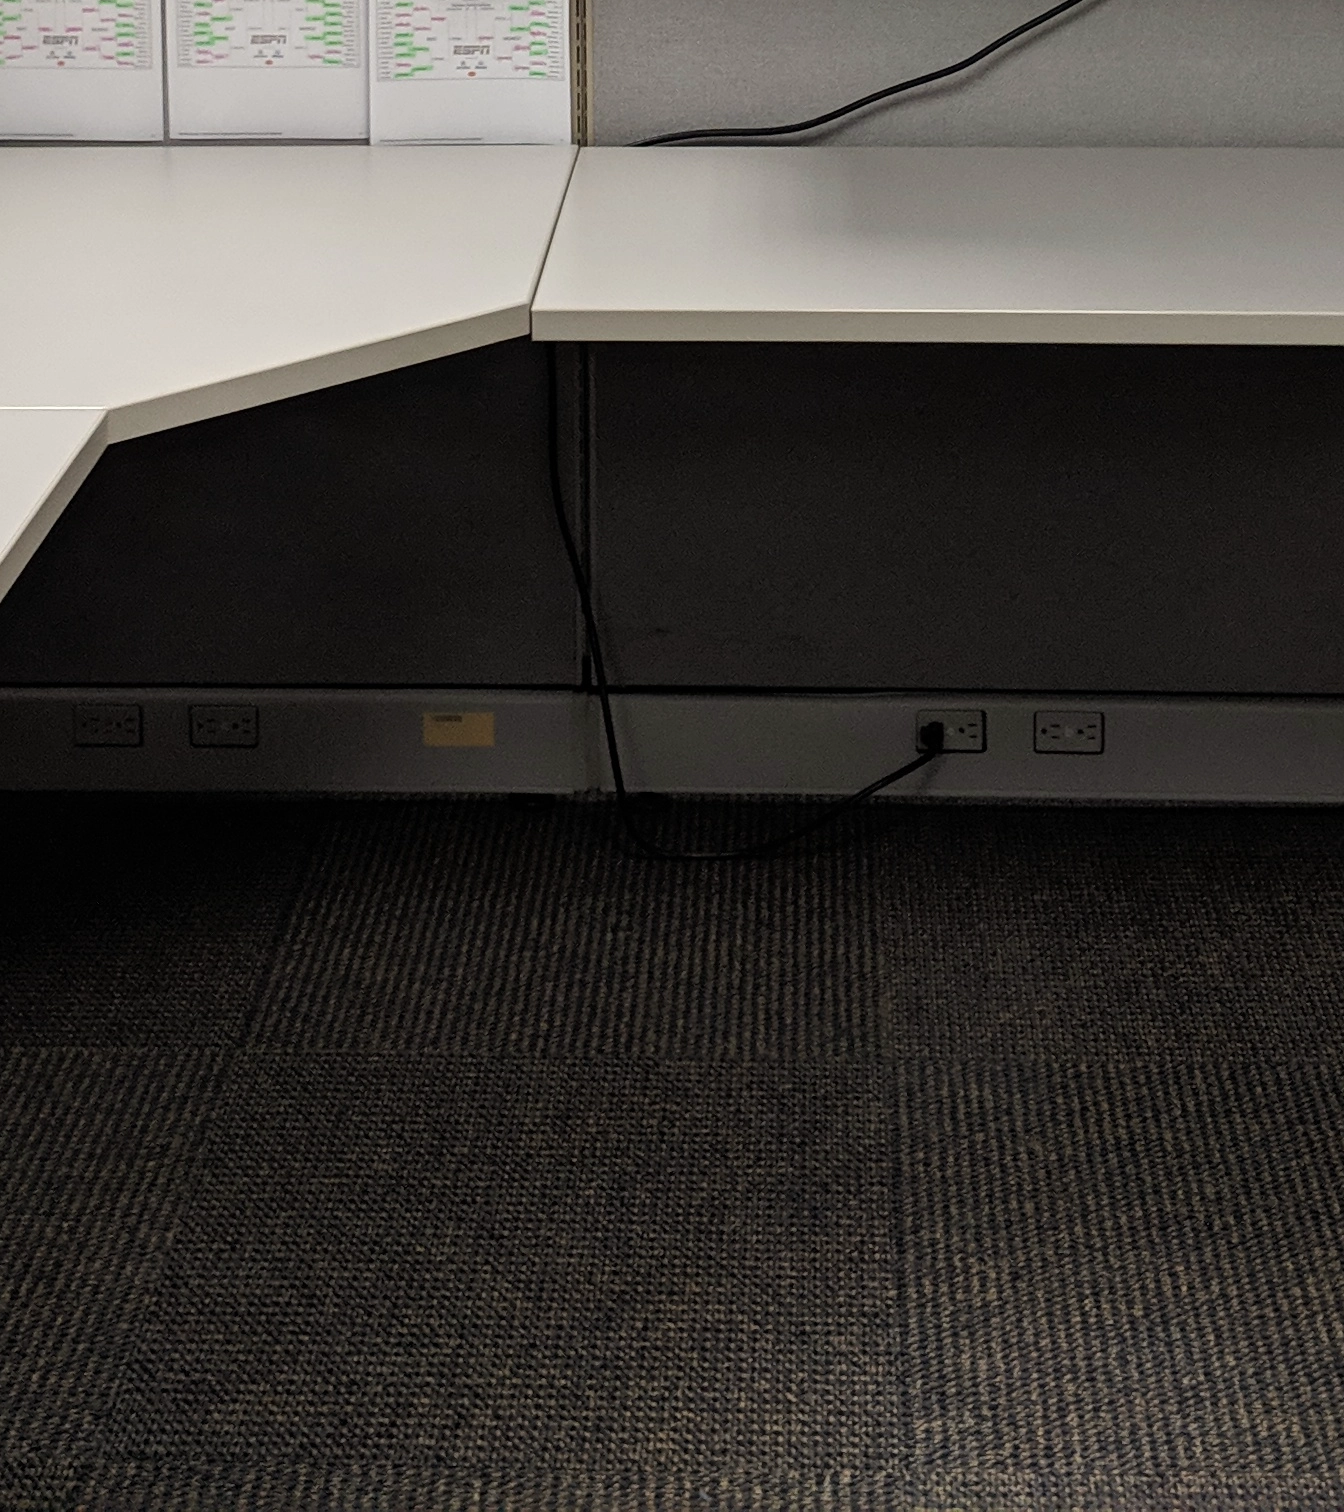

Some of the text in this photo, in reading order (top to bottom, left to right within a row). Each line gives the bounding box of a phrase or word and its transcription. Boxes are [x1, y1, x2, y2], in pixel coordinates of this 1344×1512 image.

[42, 35, 79, 45] ESPN
[250, 35, 287, 44] ESPN
[453, 45, 490, 55] ESPN
